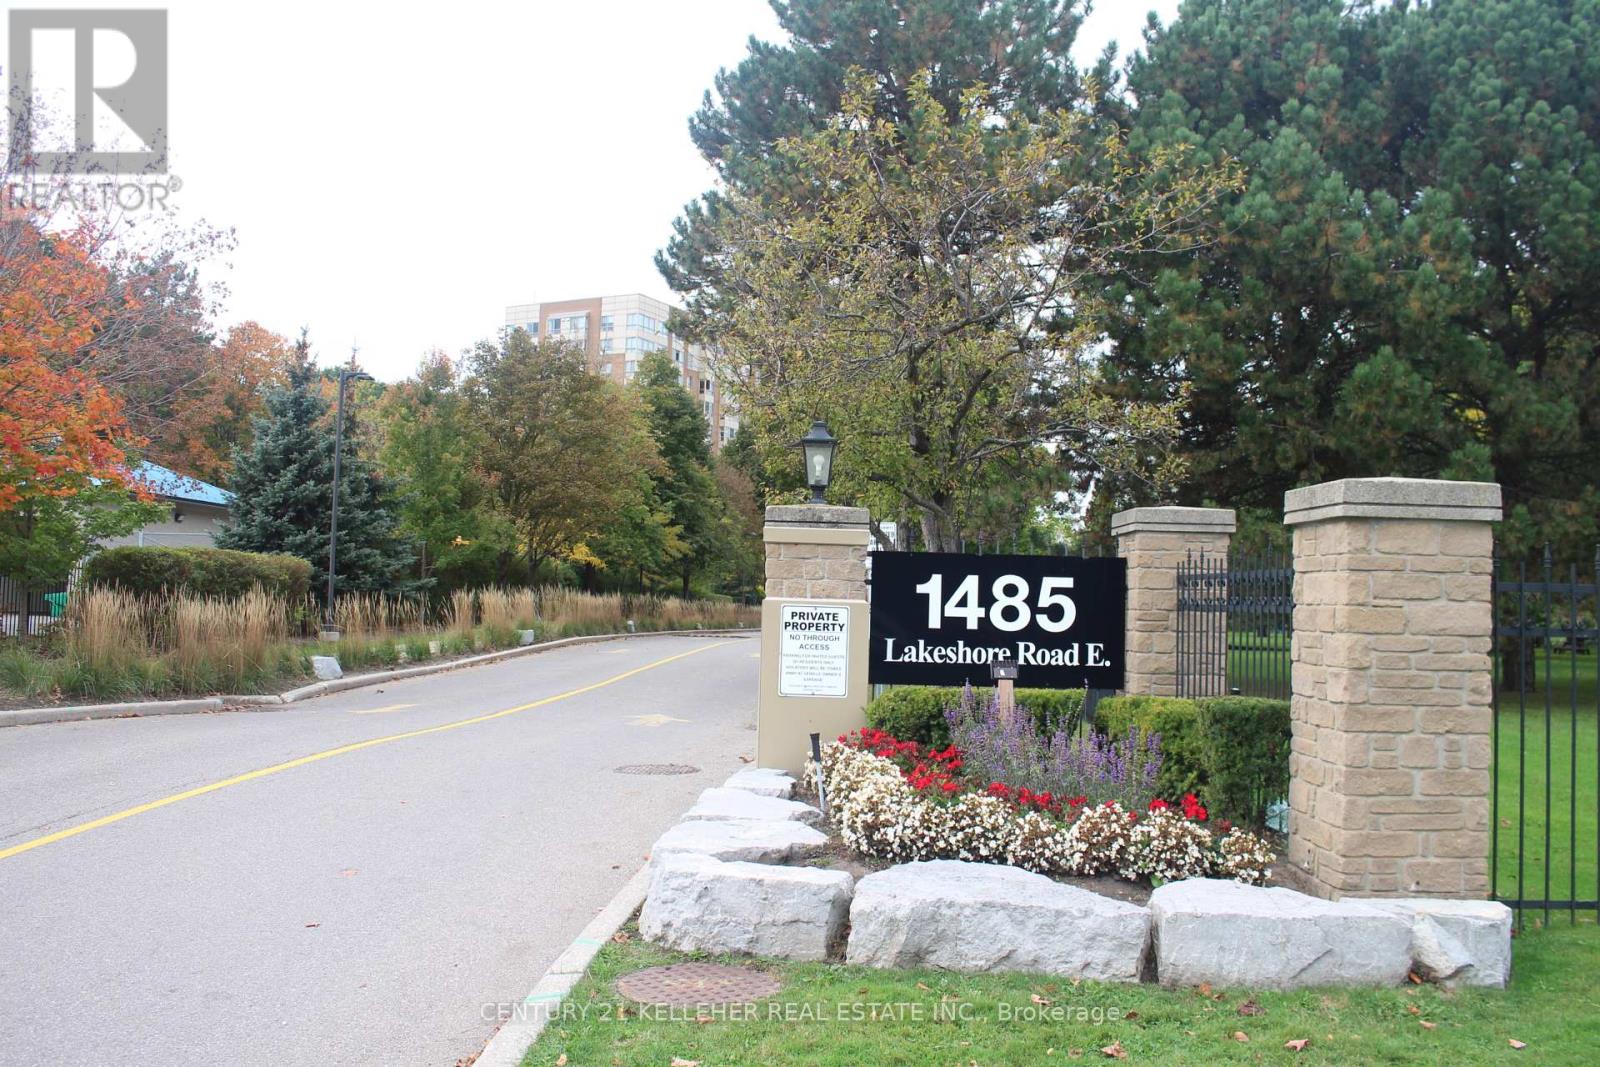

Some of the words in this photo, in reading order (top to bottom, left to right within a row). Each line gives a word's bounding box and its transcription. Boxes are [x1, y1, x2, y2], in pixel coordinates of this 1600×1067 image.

[915, 573, 1077, 633] 1485
[791, 611, 839, 621] PRIVATE
[784, 621, 845, 631] PROPERTY
[803, 634, 840, 642] THROUGH
[799, 643, 830, 651] ACCESS
[883, 638, 1011, 665] Lakeshore
[1015, 641, 1080, 666] Road
[1085, 643, 1111, 667] E.
